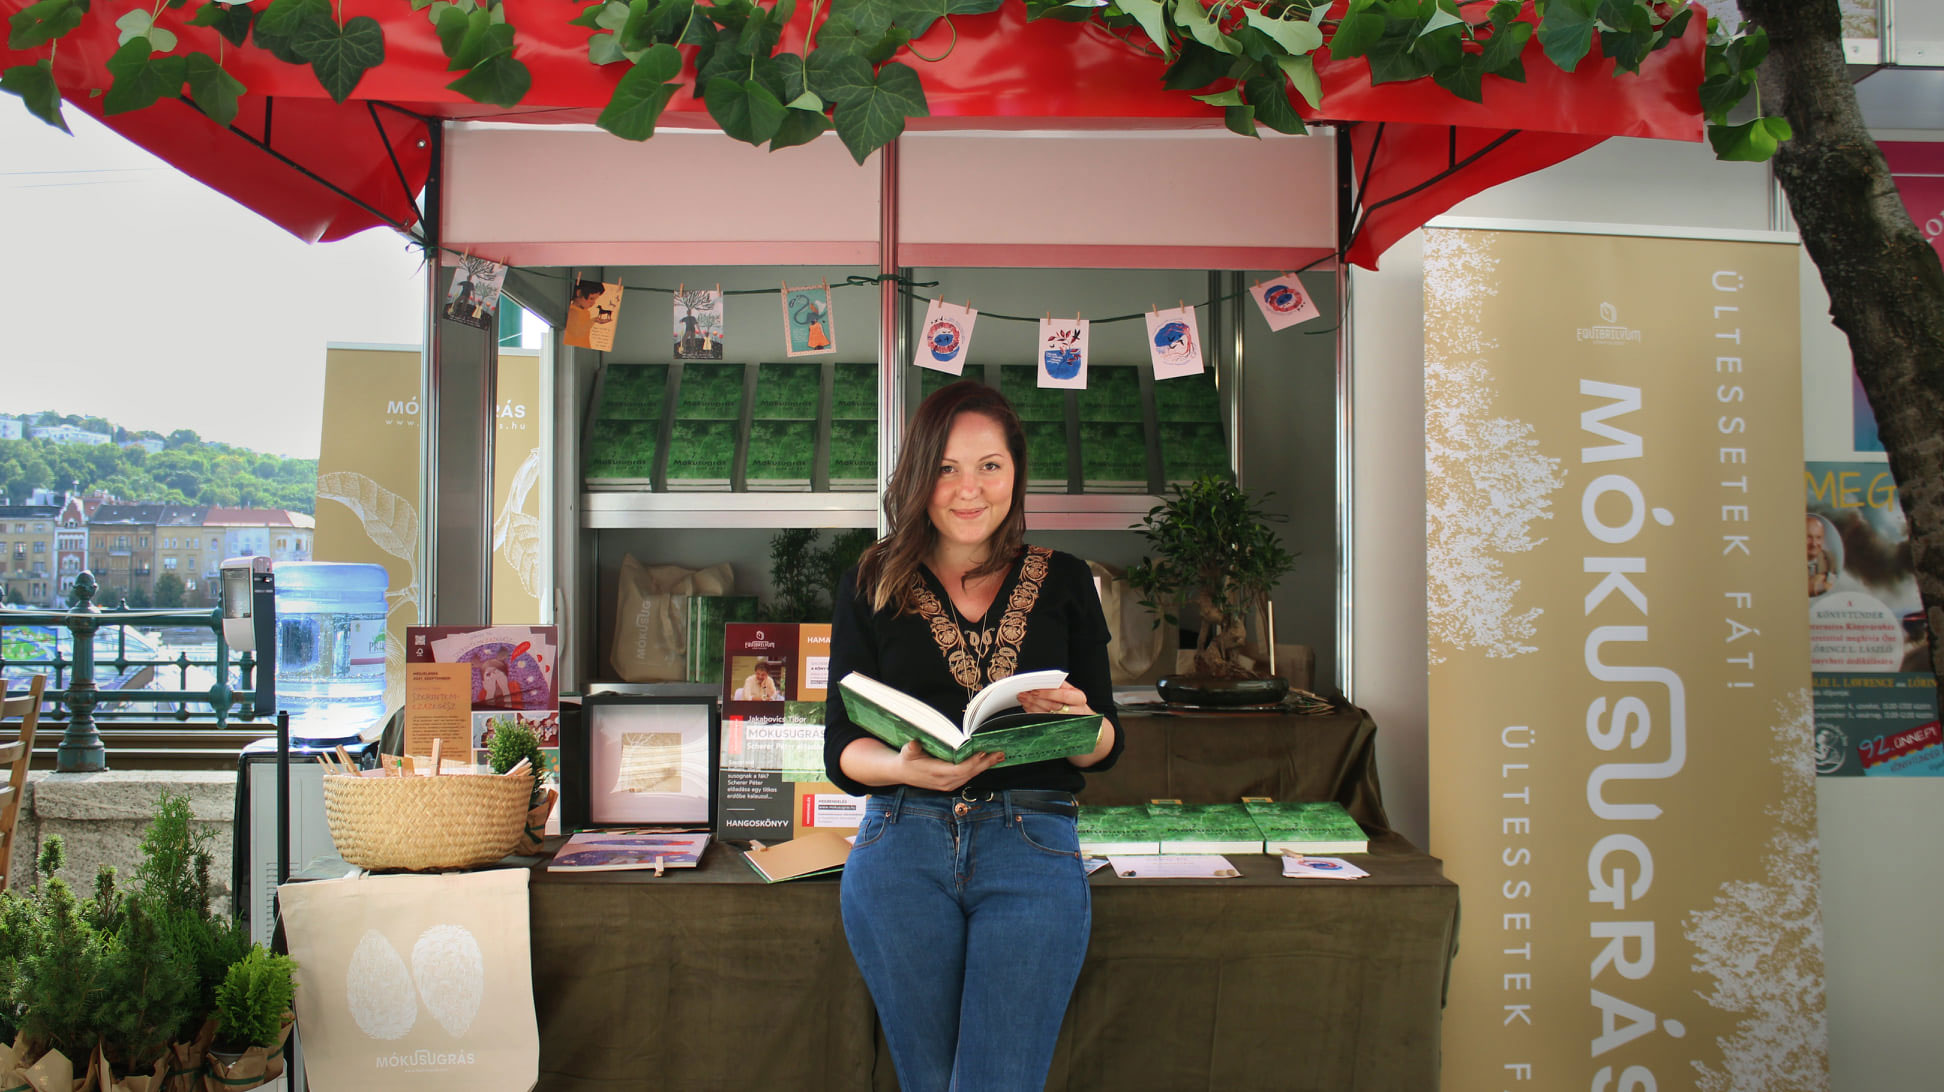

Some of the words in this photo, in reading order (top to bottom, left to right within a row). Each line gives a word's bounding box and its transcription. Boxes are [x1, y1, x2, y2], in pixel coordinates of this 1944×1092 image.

[1711, 269, 1750, 556] ÜLTESSETEK
[1724, 592, 1761, 688] FÁT!
[726, 818, 789, 828] HANGOSKÖNYV
[1501, 725, 1535, 1027] ÜLTESSETEK
